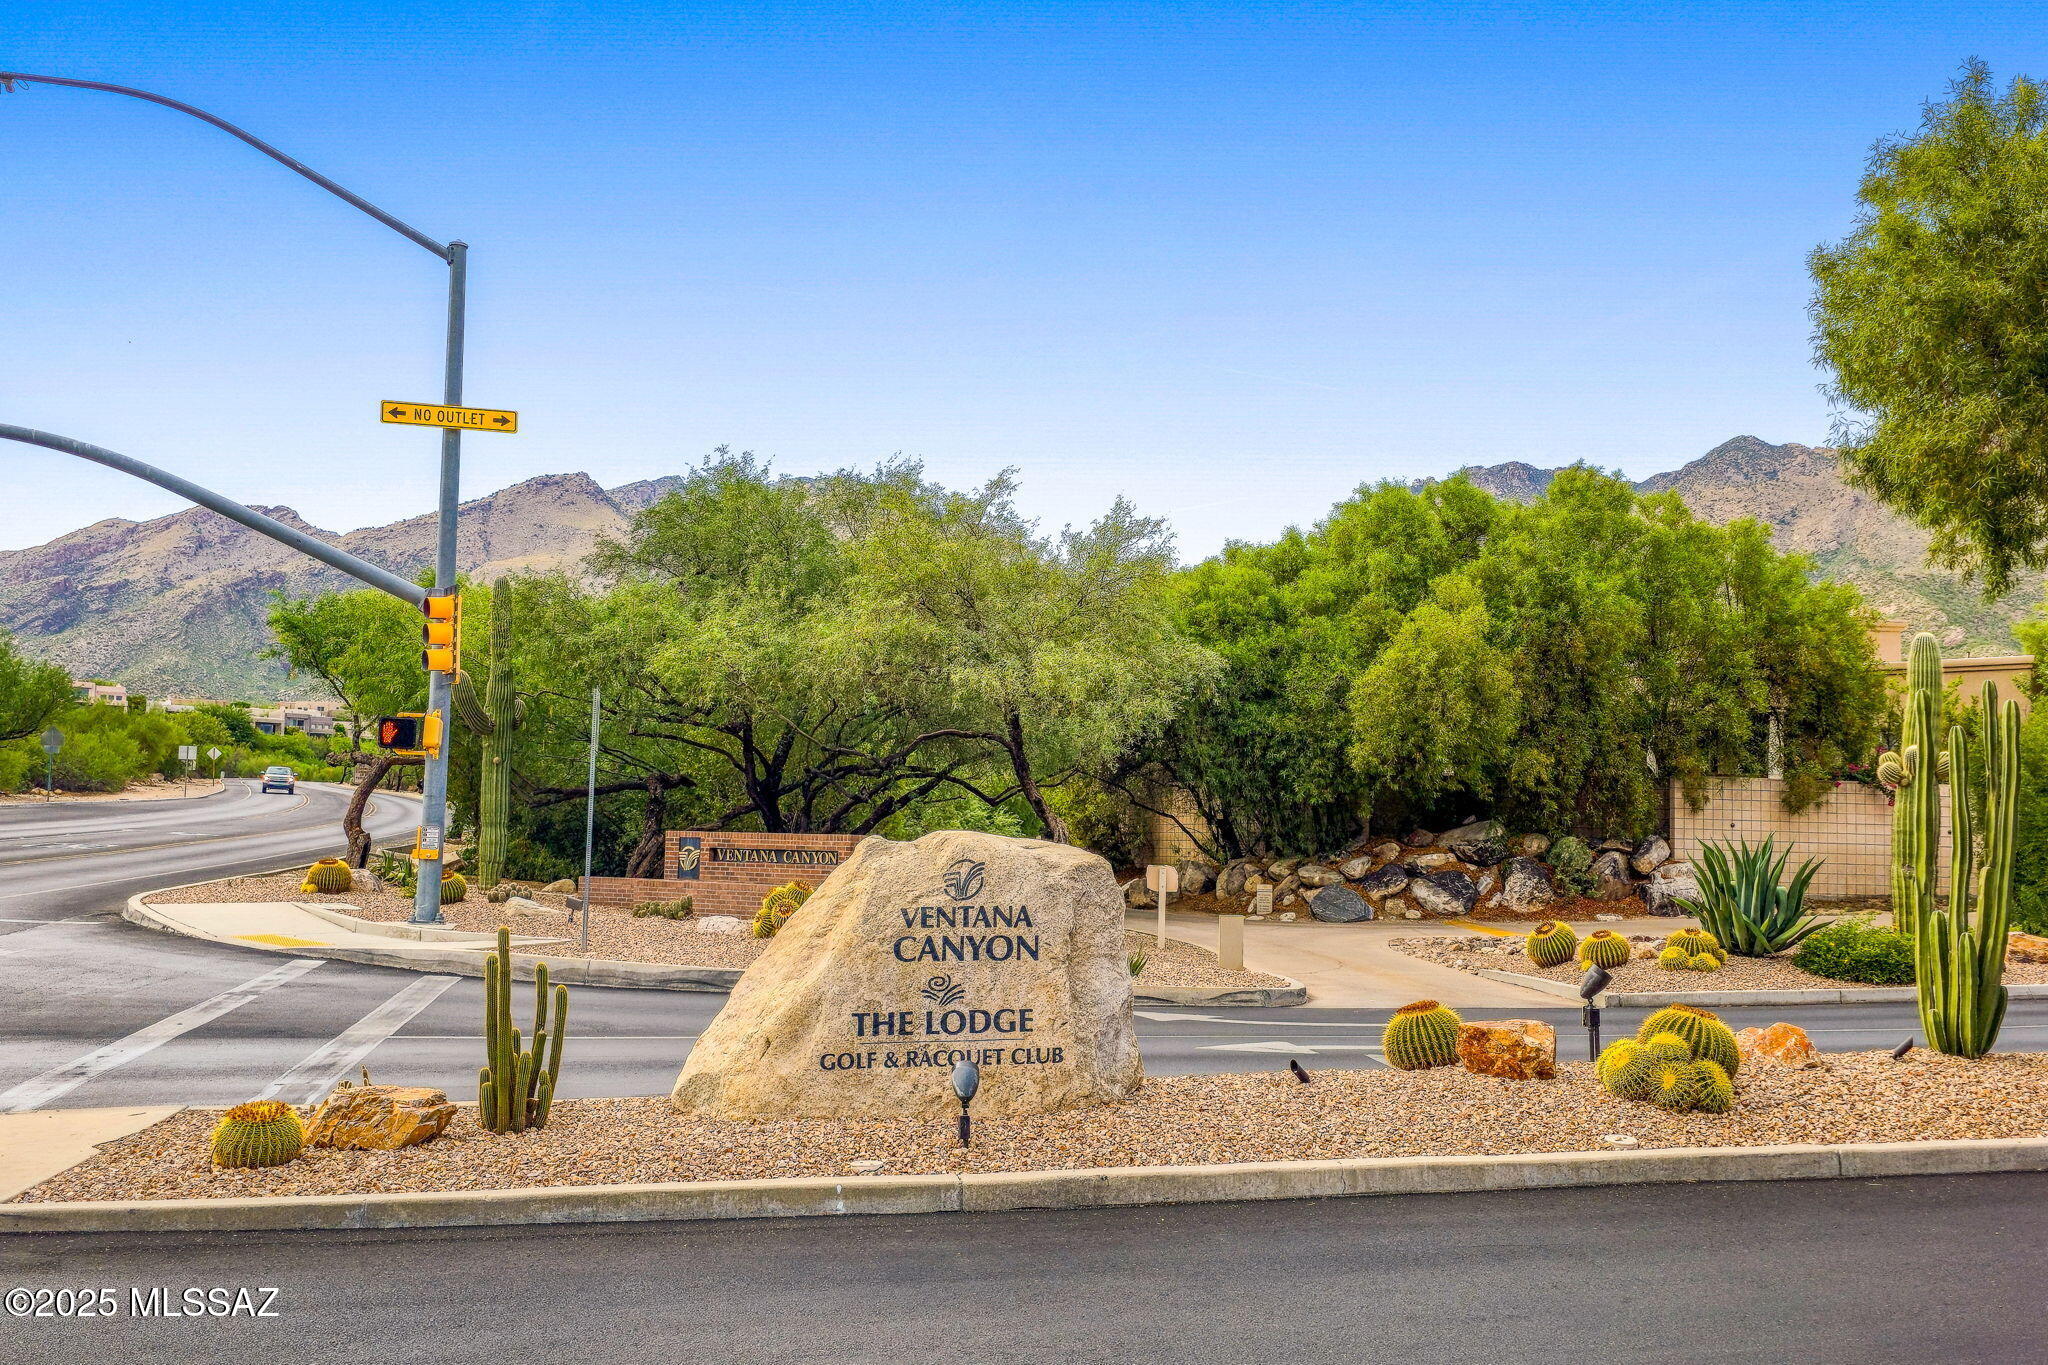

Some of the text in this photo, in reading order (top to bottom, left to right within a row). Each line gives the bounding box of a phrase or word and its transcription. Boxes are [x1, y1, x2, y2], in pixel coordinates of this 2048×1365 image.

[414, 408, 486, 426] NO OUTLET
[717, 849, 838, 865] VENTANA CANYON
[900, 905, 1033, 929] VENTANA
[893, 934, 1039, 963] CANYON
[852, 1008, 1034, 1037] THE LODGE
[819, 1051, 877, 1071] GOLF
[884, 1051, 900, 1069] &
[1011, 1047, 1064, 1065] CLUB
